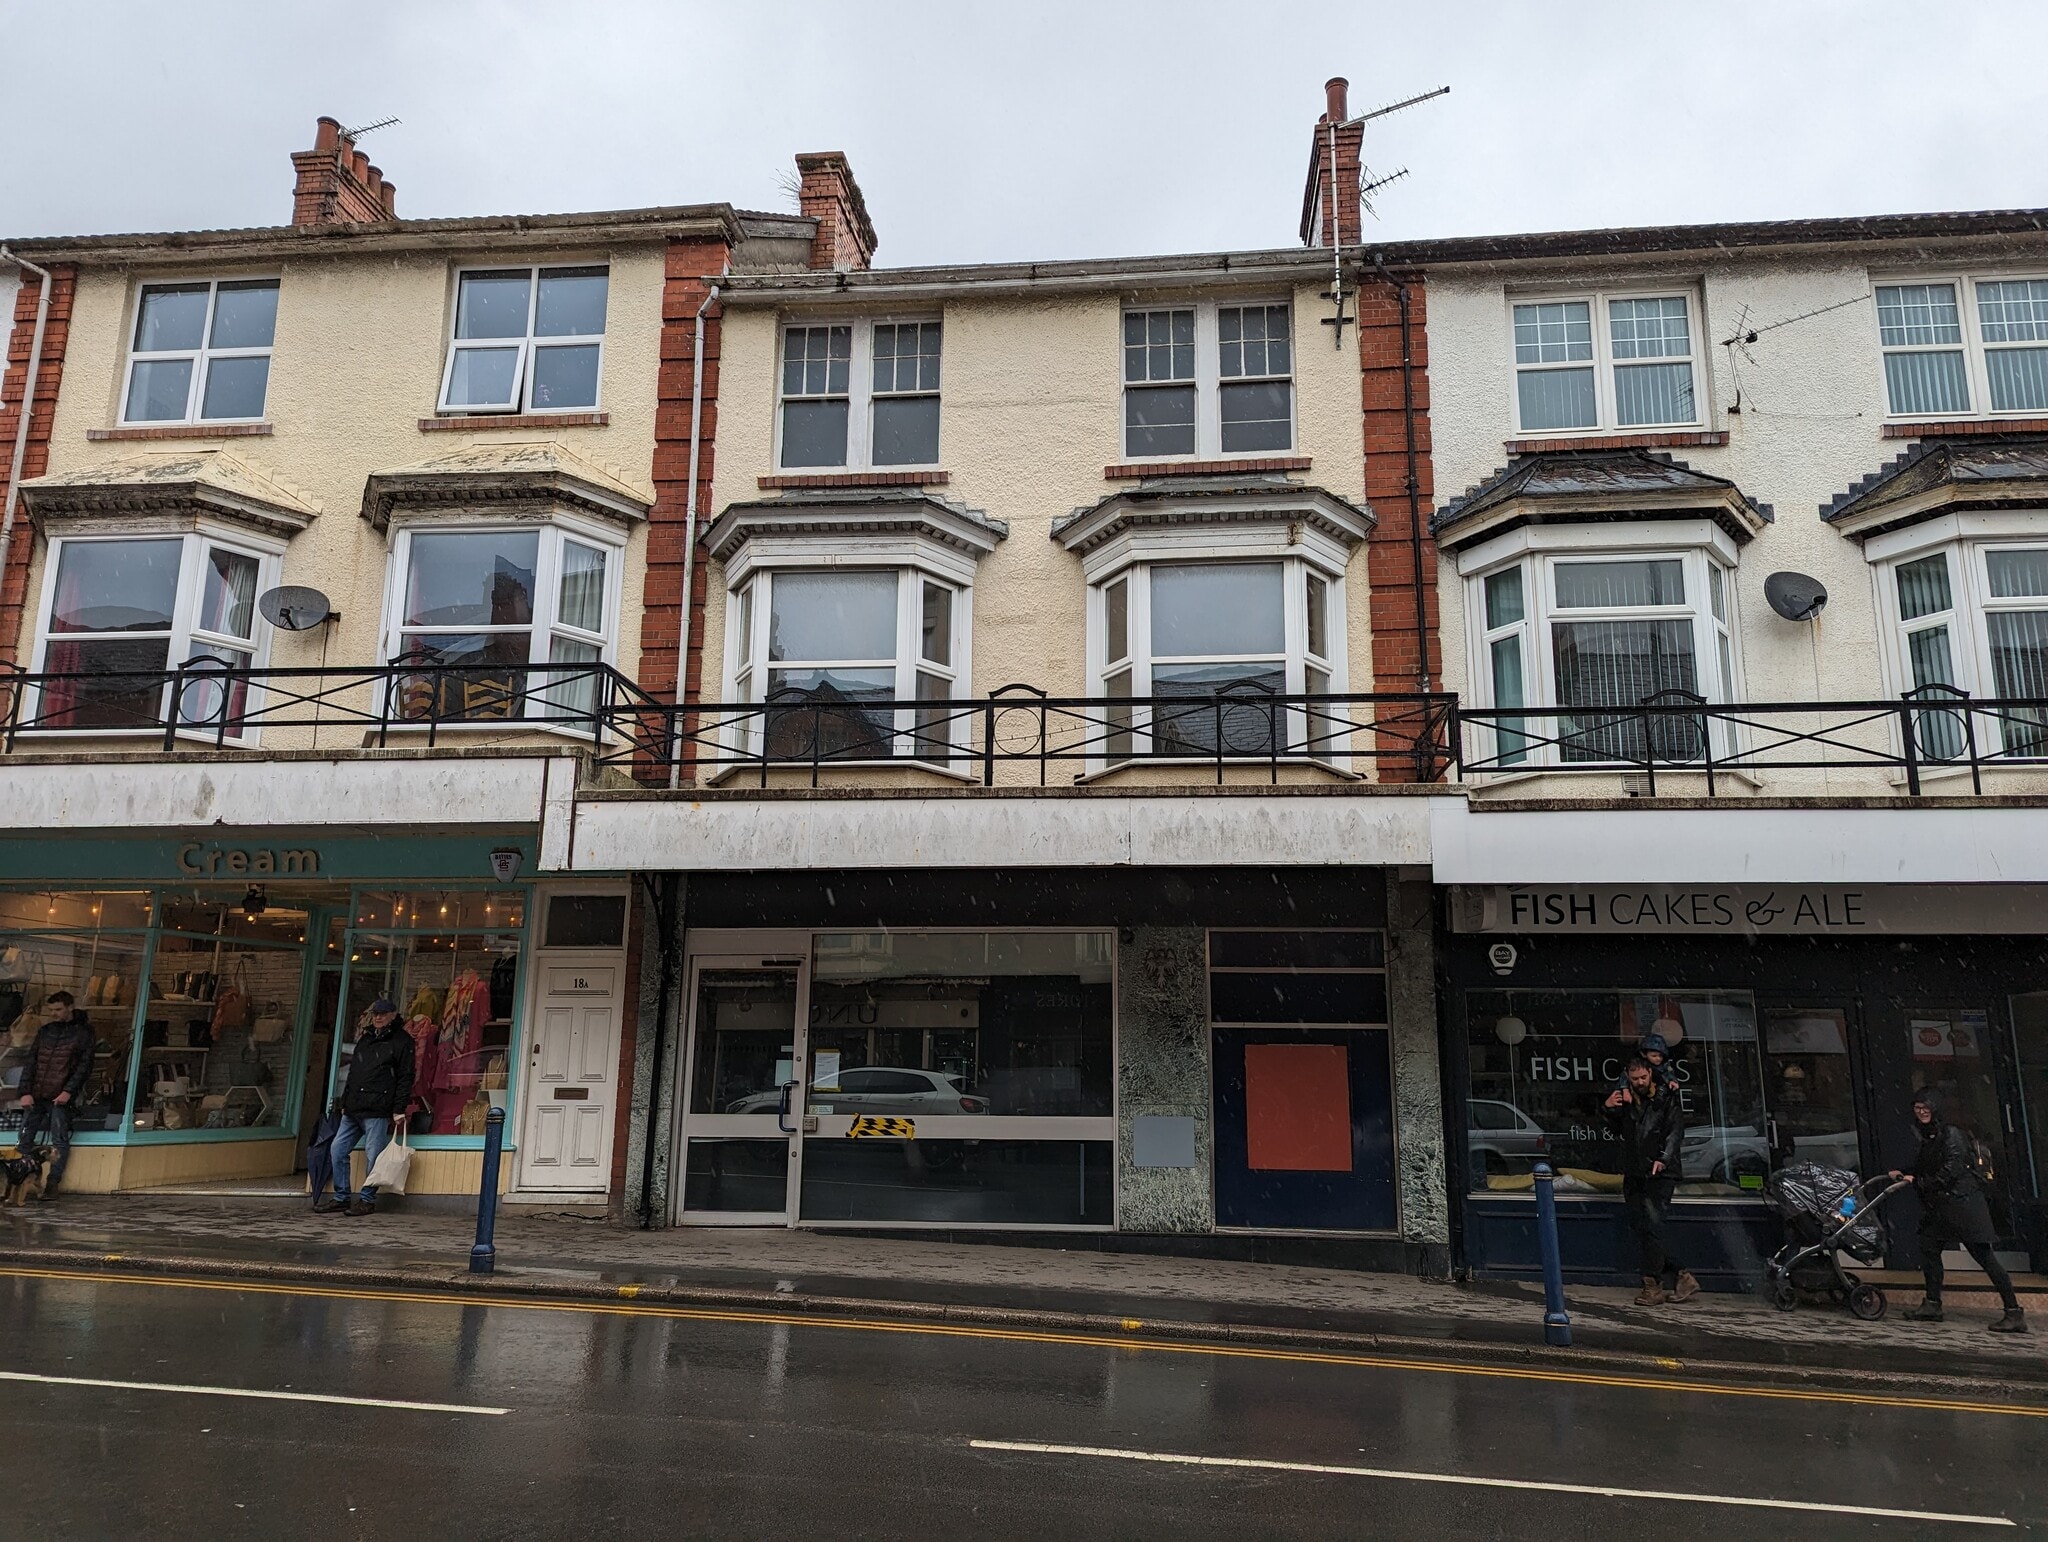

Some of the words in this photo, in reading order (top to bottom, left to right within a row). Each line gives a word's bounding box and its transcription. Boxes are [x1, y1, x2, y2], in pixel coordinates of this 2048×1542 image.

[177, 843, 319, 874] Cream
[1510, 893, 1597, 925] FISH
[1609, 893, 1733, 926] CAKES
[1745, 892, 1785, 926] &
[1793, 894, 1866, 926] ALE
[1531, 1057, 1594, 1081] FISH
[1569, 1125, 1597, 1141] fish
[1602, 1126, 1615, 1141] &
